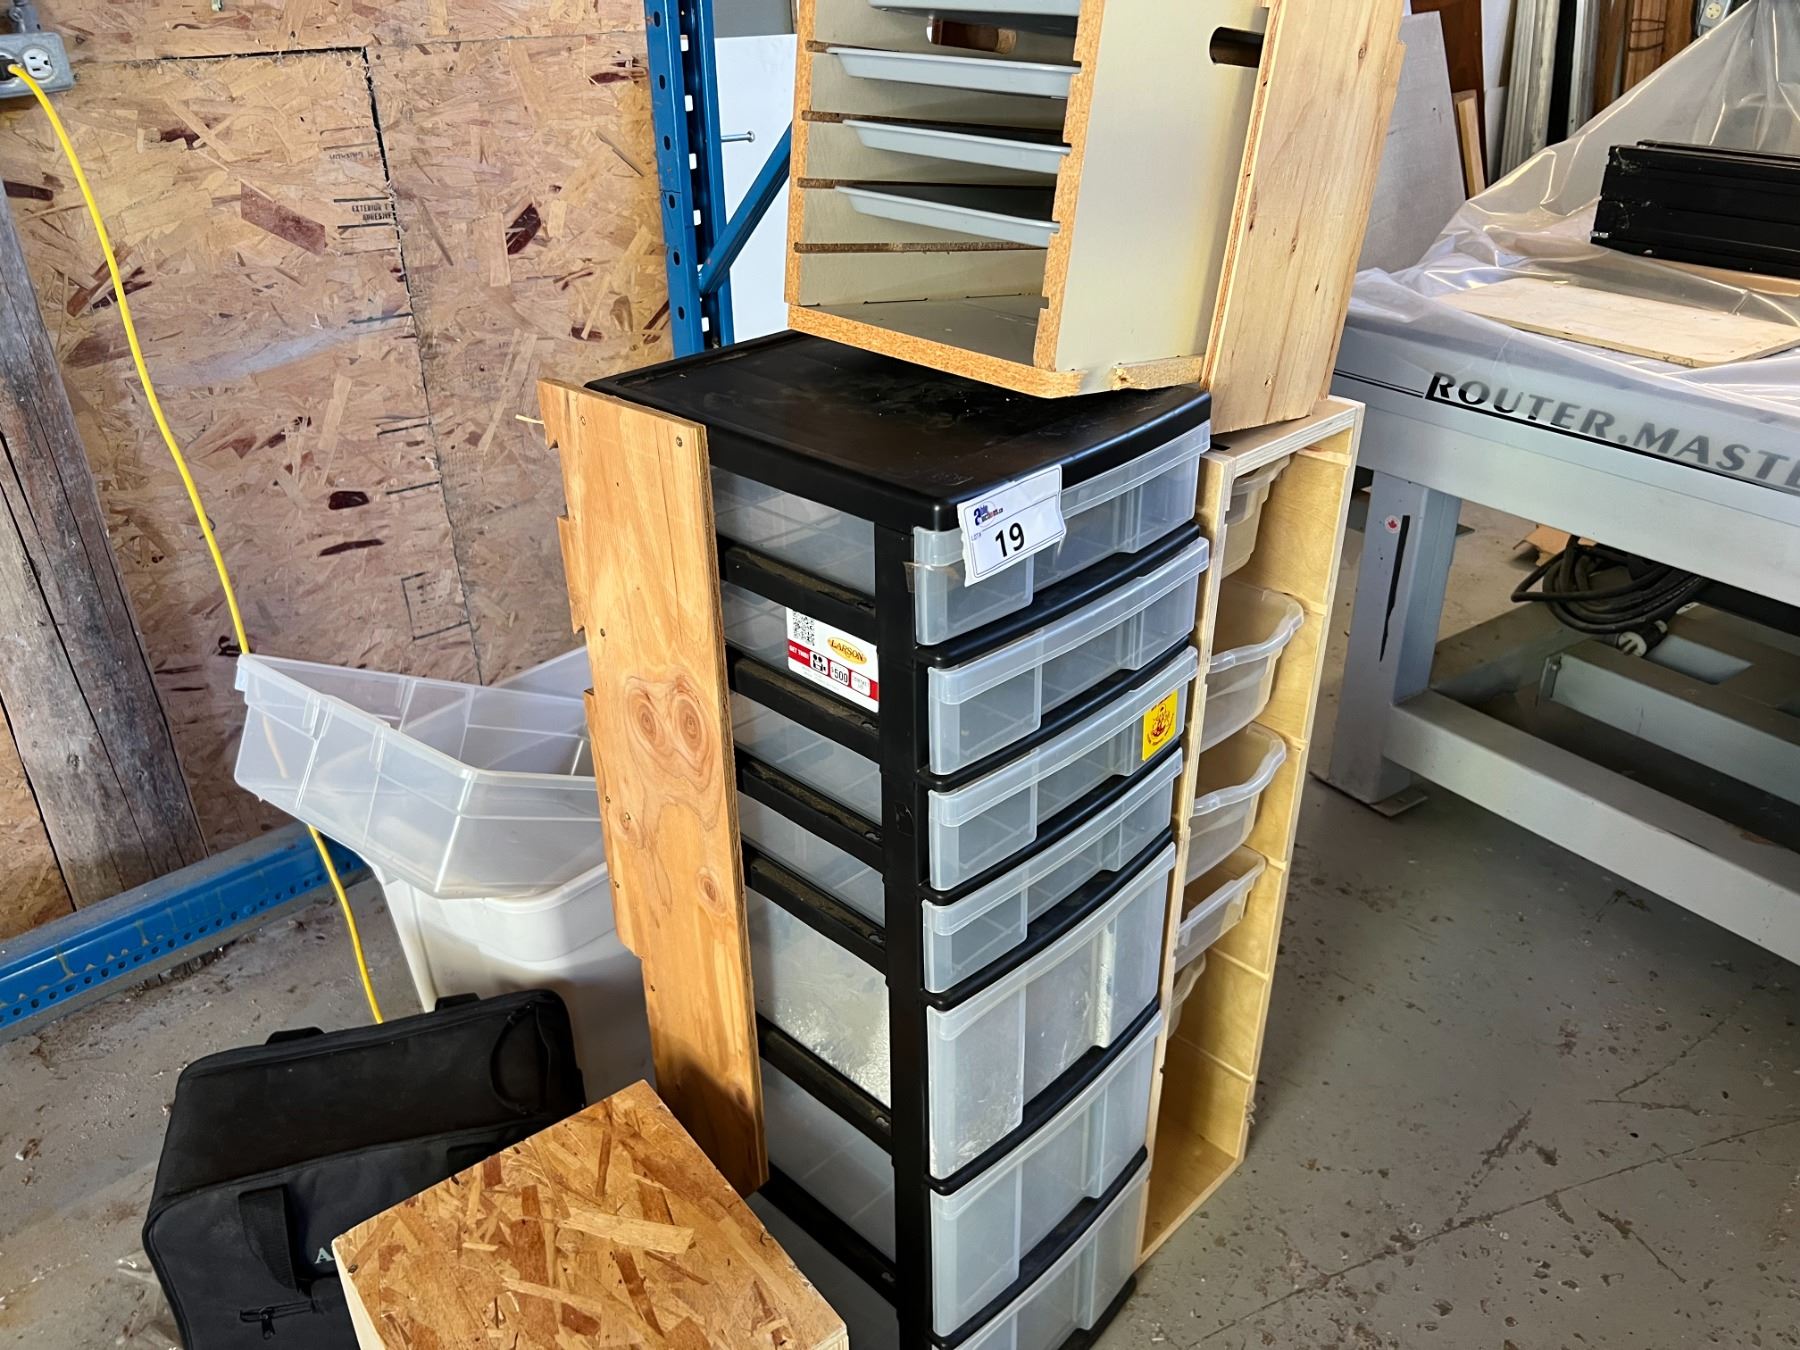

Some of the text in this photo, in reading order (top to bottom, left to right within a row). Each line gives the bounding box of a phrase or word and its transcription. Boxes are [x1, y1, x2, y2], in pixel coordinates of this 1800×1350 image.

[351, 203, 381, 213] EXTERIOR
[995, 522, 1025, 557] 19
[830, 639, 864, 662] LARSON
